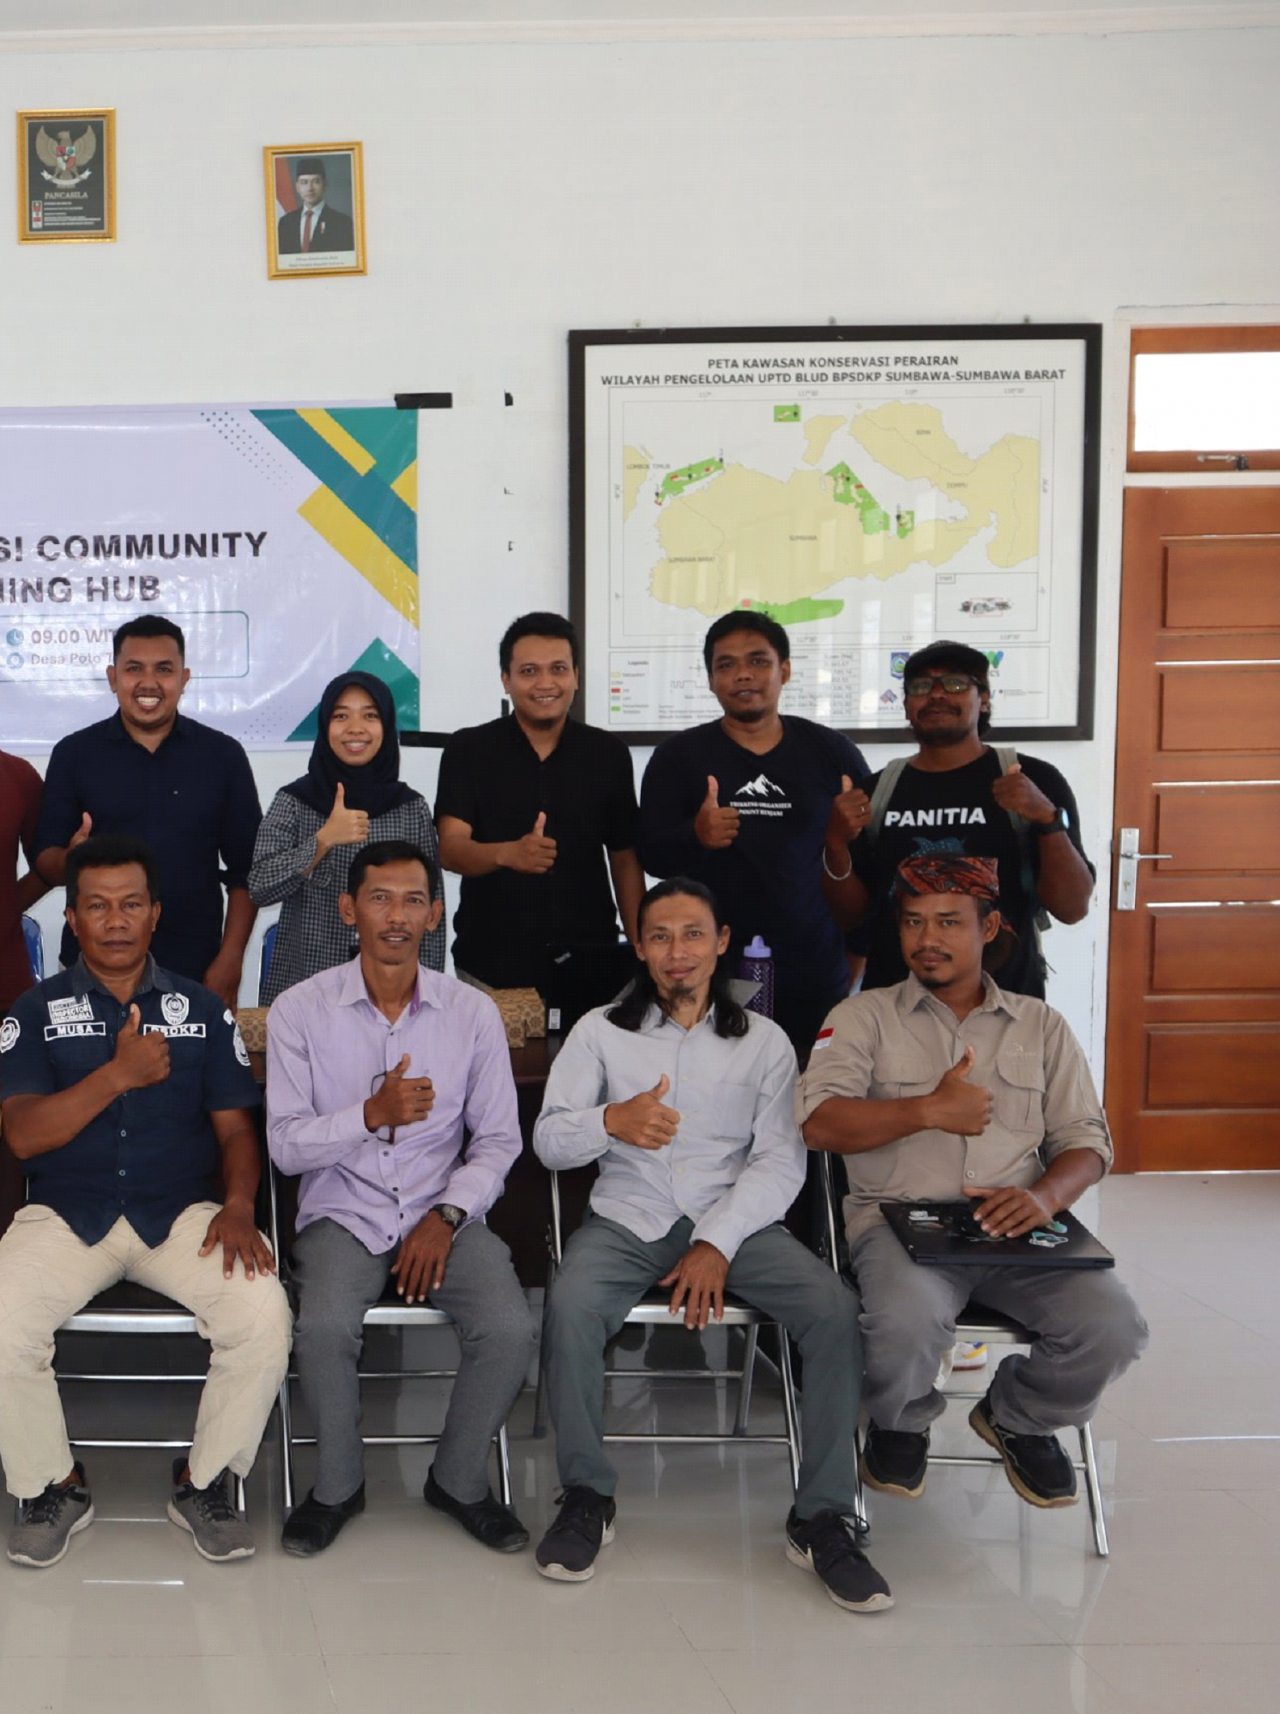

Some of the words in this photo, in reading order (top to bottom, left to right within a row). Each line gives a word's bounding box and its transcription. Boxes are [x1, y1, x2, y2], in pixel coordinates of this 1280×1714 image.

[44, 191, 89, 200] PANCASILA
[708, 358, 739, 369] PETA
[742, 357, 805, 368] KAWASAN
[809, 356, 890, 368] KONSERVASI
[894, 355, 959, 366] PERAIRAN
[601, 375, 660, 386] WILAYAH
[664, 374, 754, 385] PENGELOLAAN
[758, 373, 791, 383] UPTD
[795, 372, 829, 383] BLUD
[832, 371, 881, 382] BPSDKP
[885, 370, 1021, 382] SUMBAWA-SUMBAWA
[1024, 369, 1066, 380] BARAT
[36, 531, 267, 562] COMMUNITY
[86, 575, 161, 603] HUB
[31, 629, 80, 644] 09.00
[85, 628, 118, 643] WIT
[31, 652, 65, 665] Desa
[884, 807, 987, 827] PANITIA
[57, 1024, 94, 1036] MUSA
